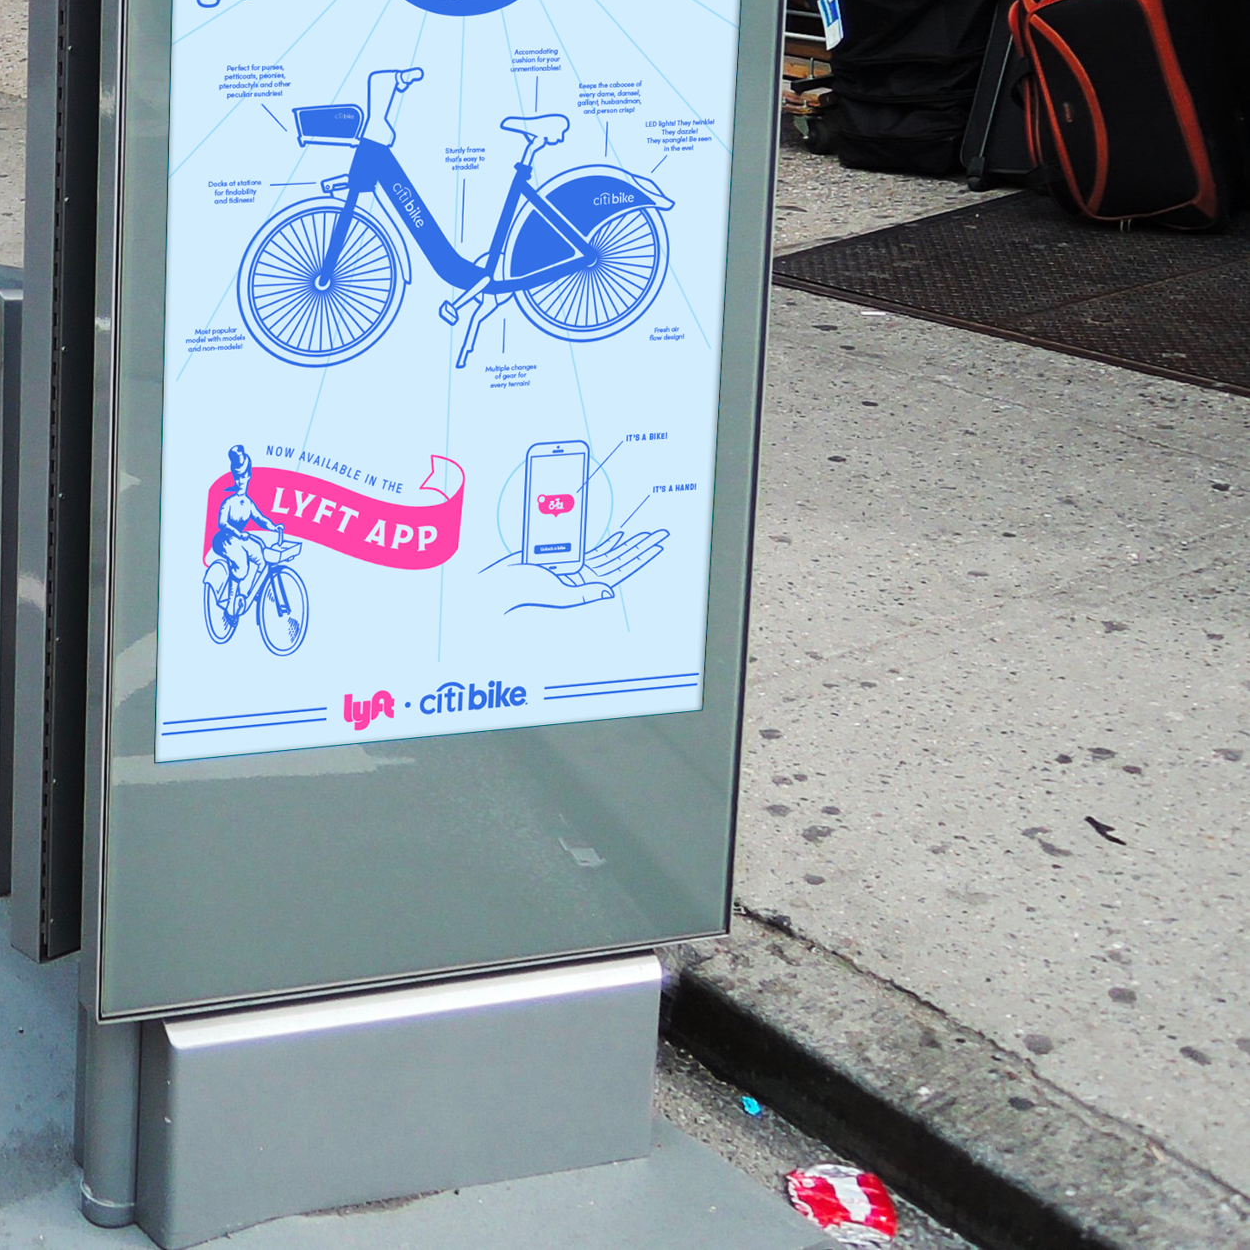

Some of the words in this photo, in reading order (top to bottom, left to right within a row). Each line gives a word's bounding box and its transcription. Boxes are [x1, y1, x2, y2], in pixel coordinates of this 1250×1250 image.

[641, 433, 647, 441] A
[649, 432, 668, 441] BIKE!
[266, 445, 295, 458] NOW
[298, 451, 362, 481] AVAILABLE
[364, 474, 377, 487] IN
[382, 479, 403, 494] THE
[675, 483, 697, 492] HAND!
[270, 487, 359, 533] LYFT
[363, 519, 438, 552] APP
[343, 689, 395, 731] lyft
